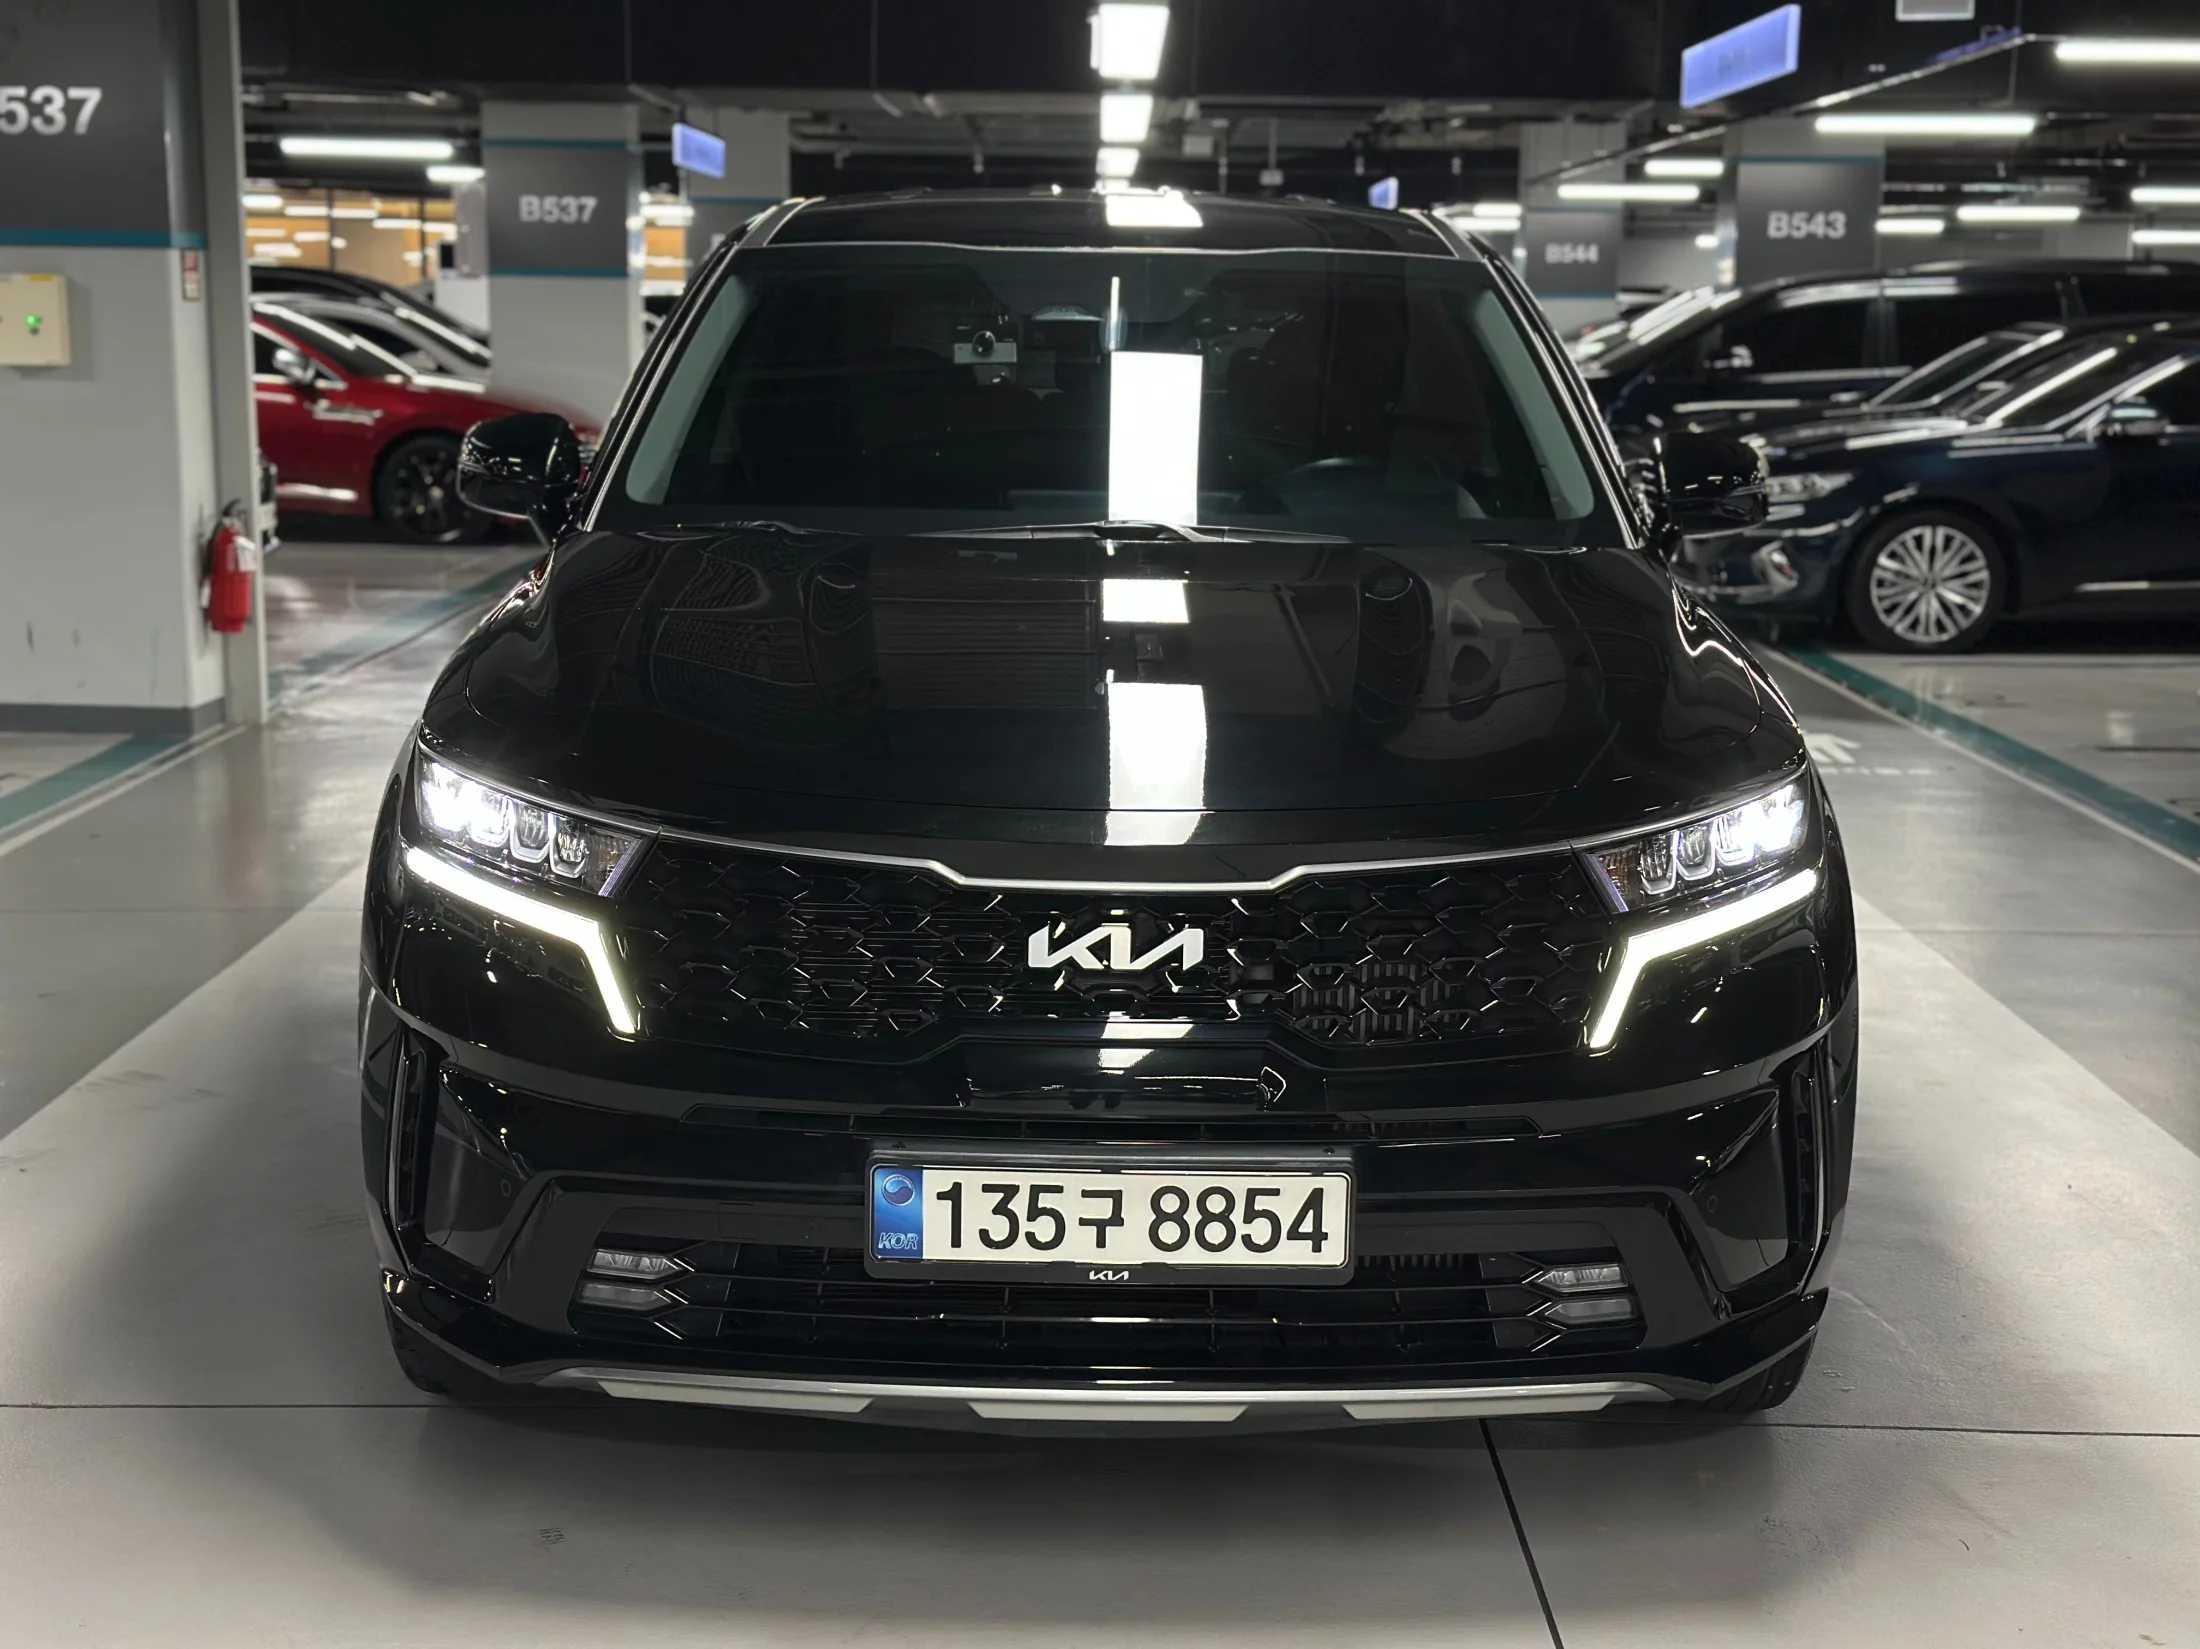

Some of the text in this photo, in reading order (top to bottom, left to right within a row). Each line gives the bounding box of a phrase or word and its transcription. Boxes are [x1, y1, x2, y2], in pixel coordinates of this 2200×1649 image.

[0, 85, 103, 135] 537
[519, 194, 599, 224] B537
[1767, 210, 1847, 240] B543
[1544, 242, 1599, 264] B544
[1028, 923, 1204, 971] KIA
[936, 1181, 1329, 1254] 135구 8854
[878, 1232, 919, 1250] KOR
[1089, 1270, 1129, 1281] KIA
